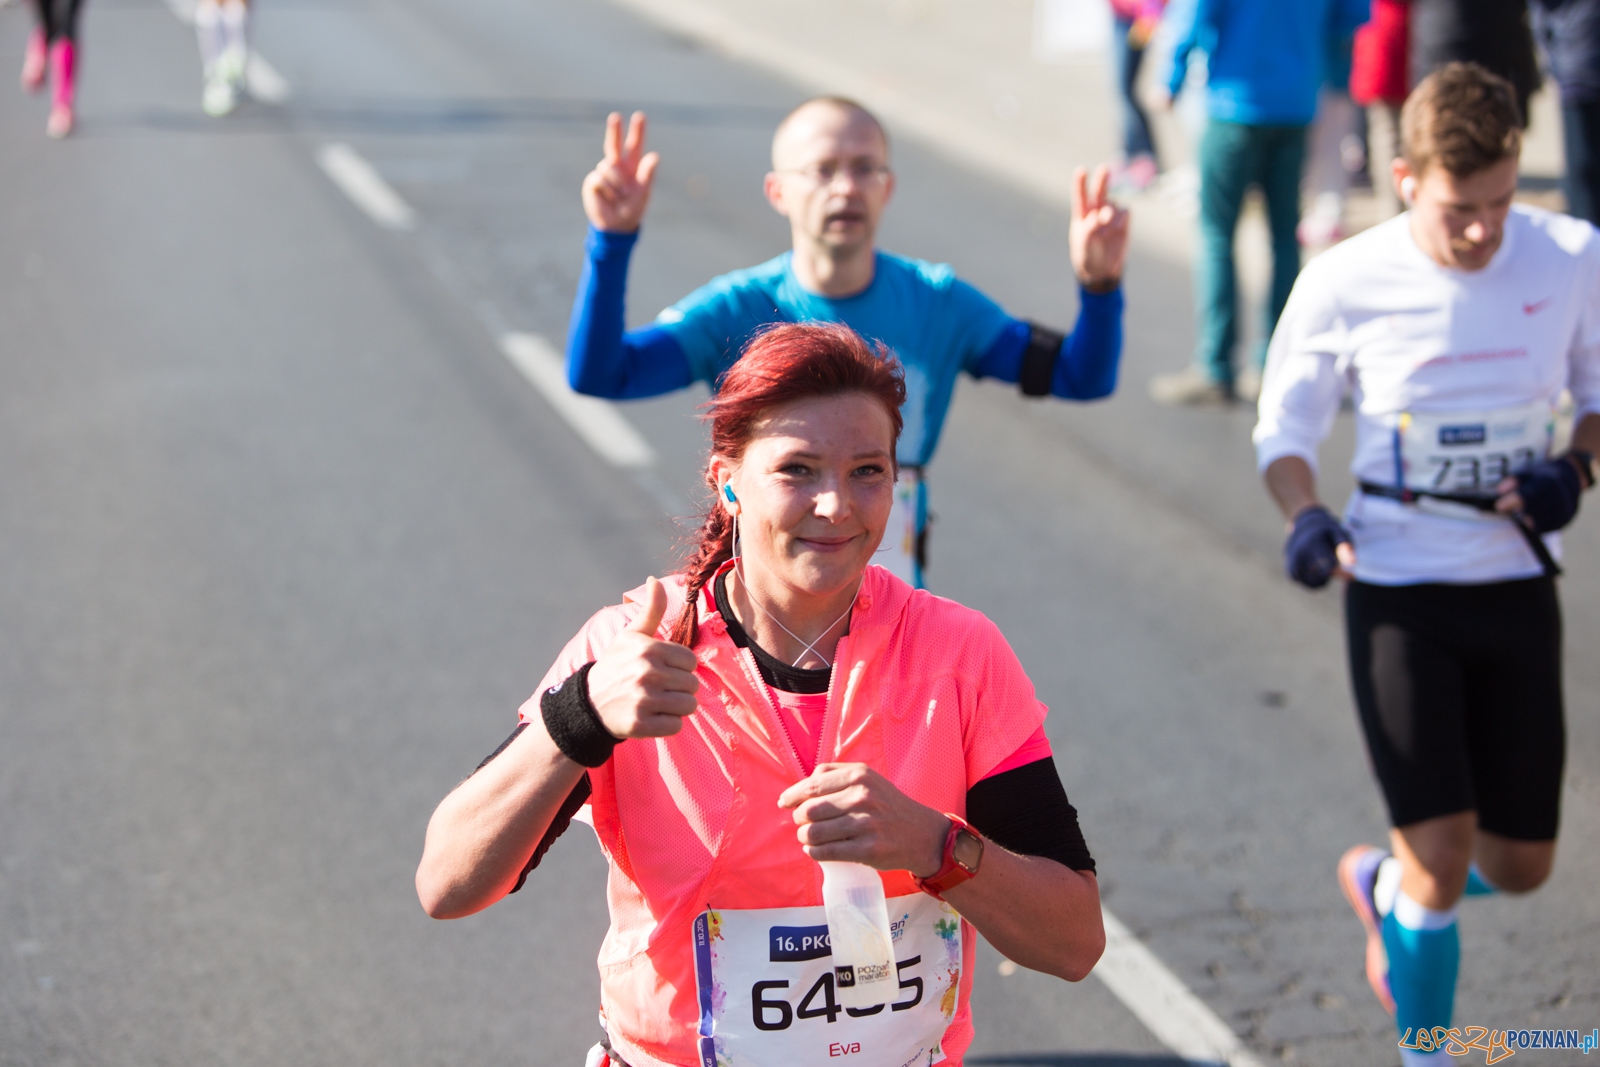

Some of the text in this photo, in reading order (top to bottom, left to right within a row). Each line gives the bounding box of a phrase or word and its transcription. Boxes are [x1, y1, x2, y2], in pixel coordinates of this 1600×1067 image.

[775, 936, 799, 952] 16.
[859, 970, 891, 982] maraton
[751, 954, 924, 1031] 645
[829, 1042, 861, 1057] Eva
